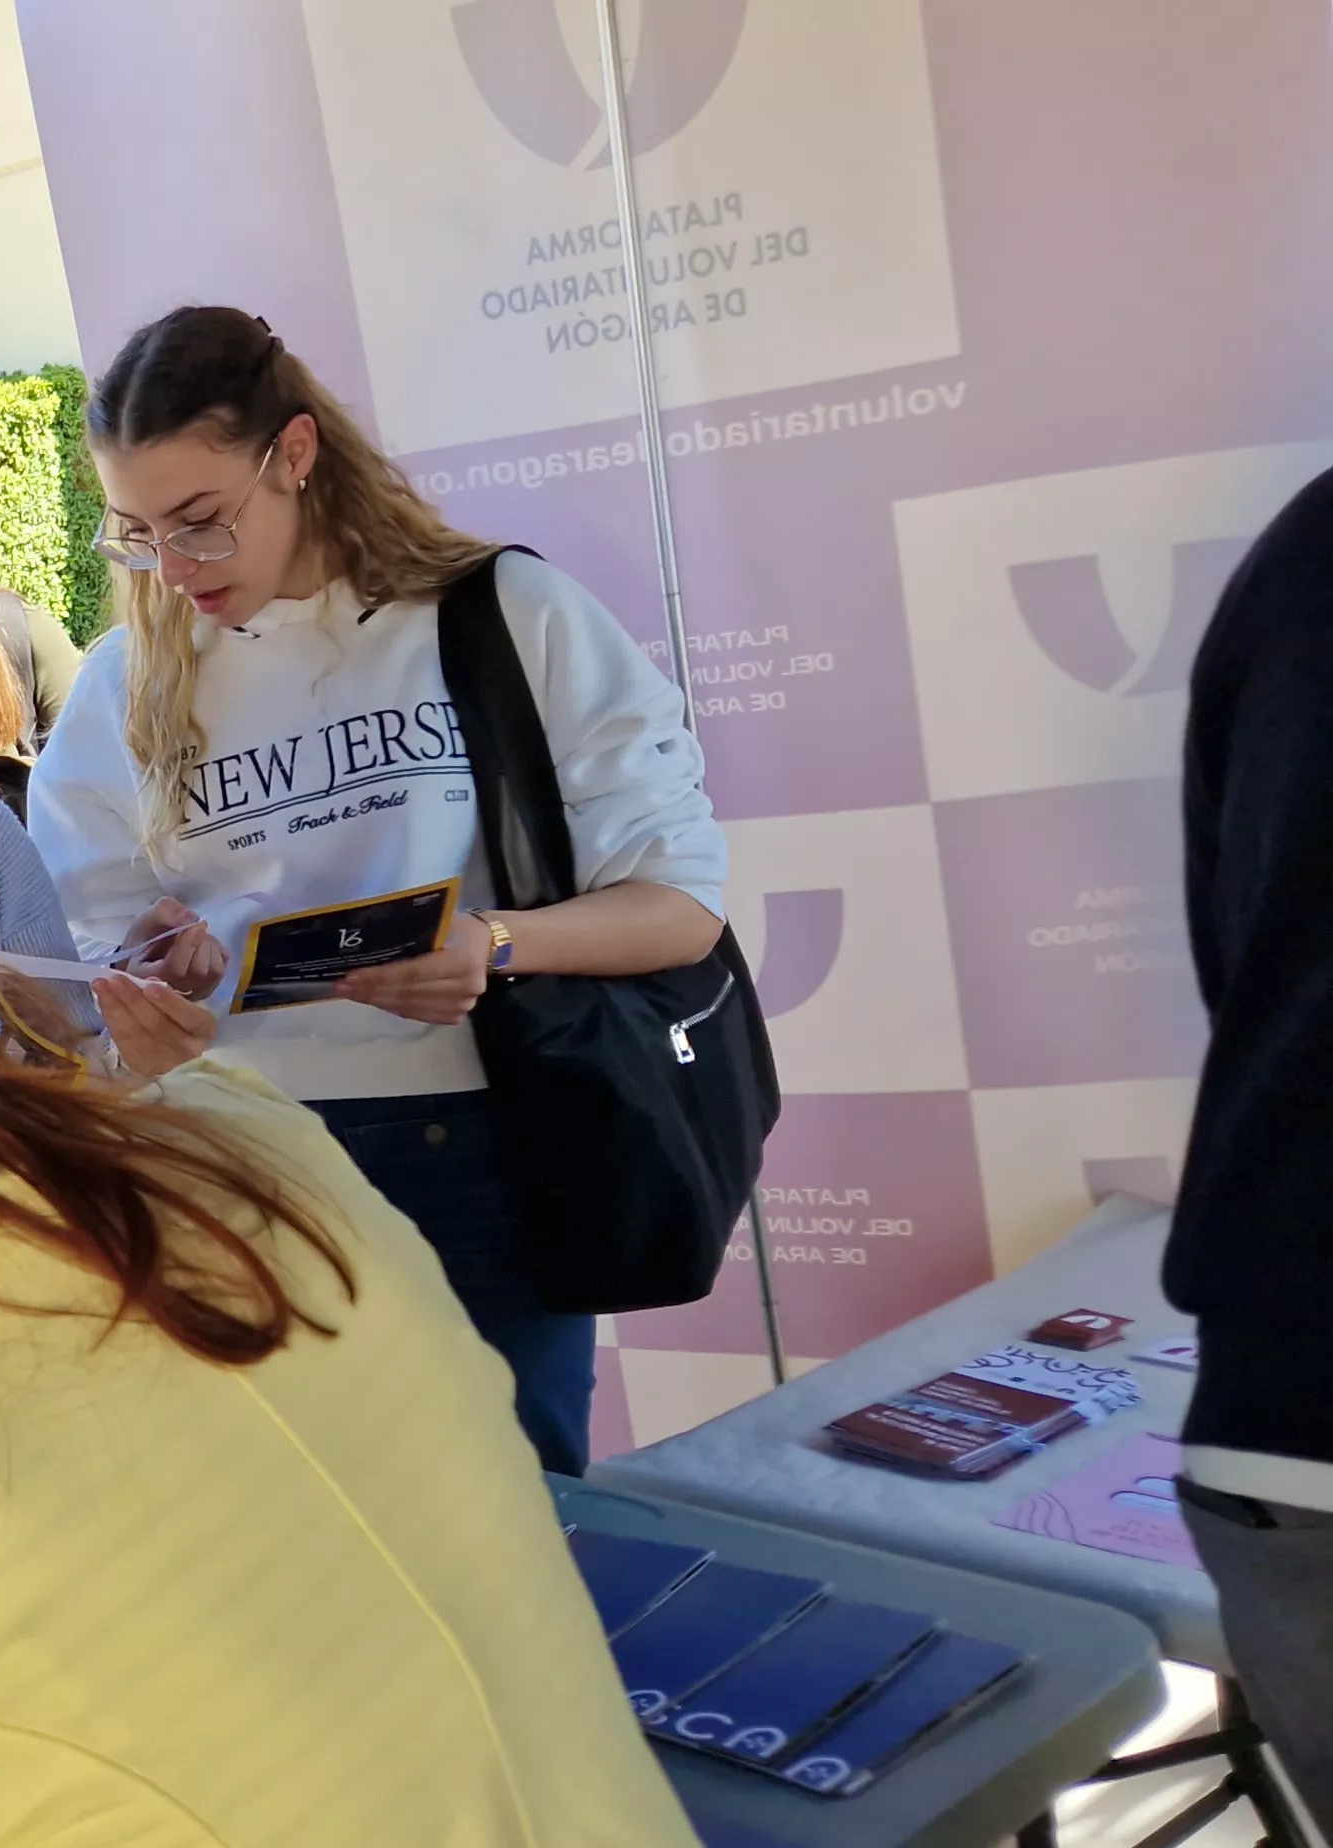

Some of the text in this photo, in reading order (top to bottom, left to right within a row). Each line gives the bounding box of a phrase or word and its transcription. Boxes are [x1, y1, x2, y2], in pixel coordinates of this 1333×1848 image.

[179, 700, 470, 826] NEW JERSE
[227, 830, 267, 851] SPORTS
[287, 807, 339, 834] Track
[356, 789, 409, 815] Field
